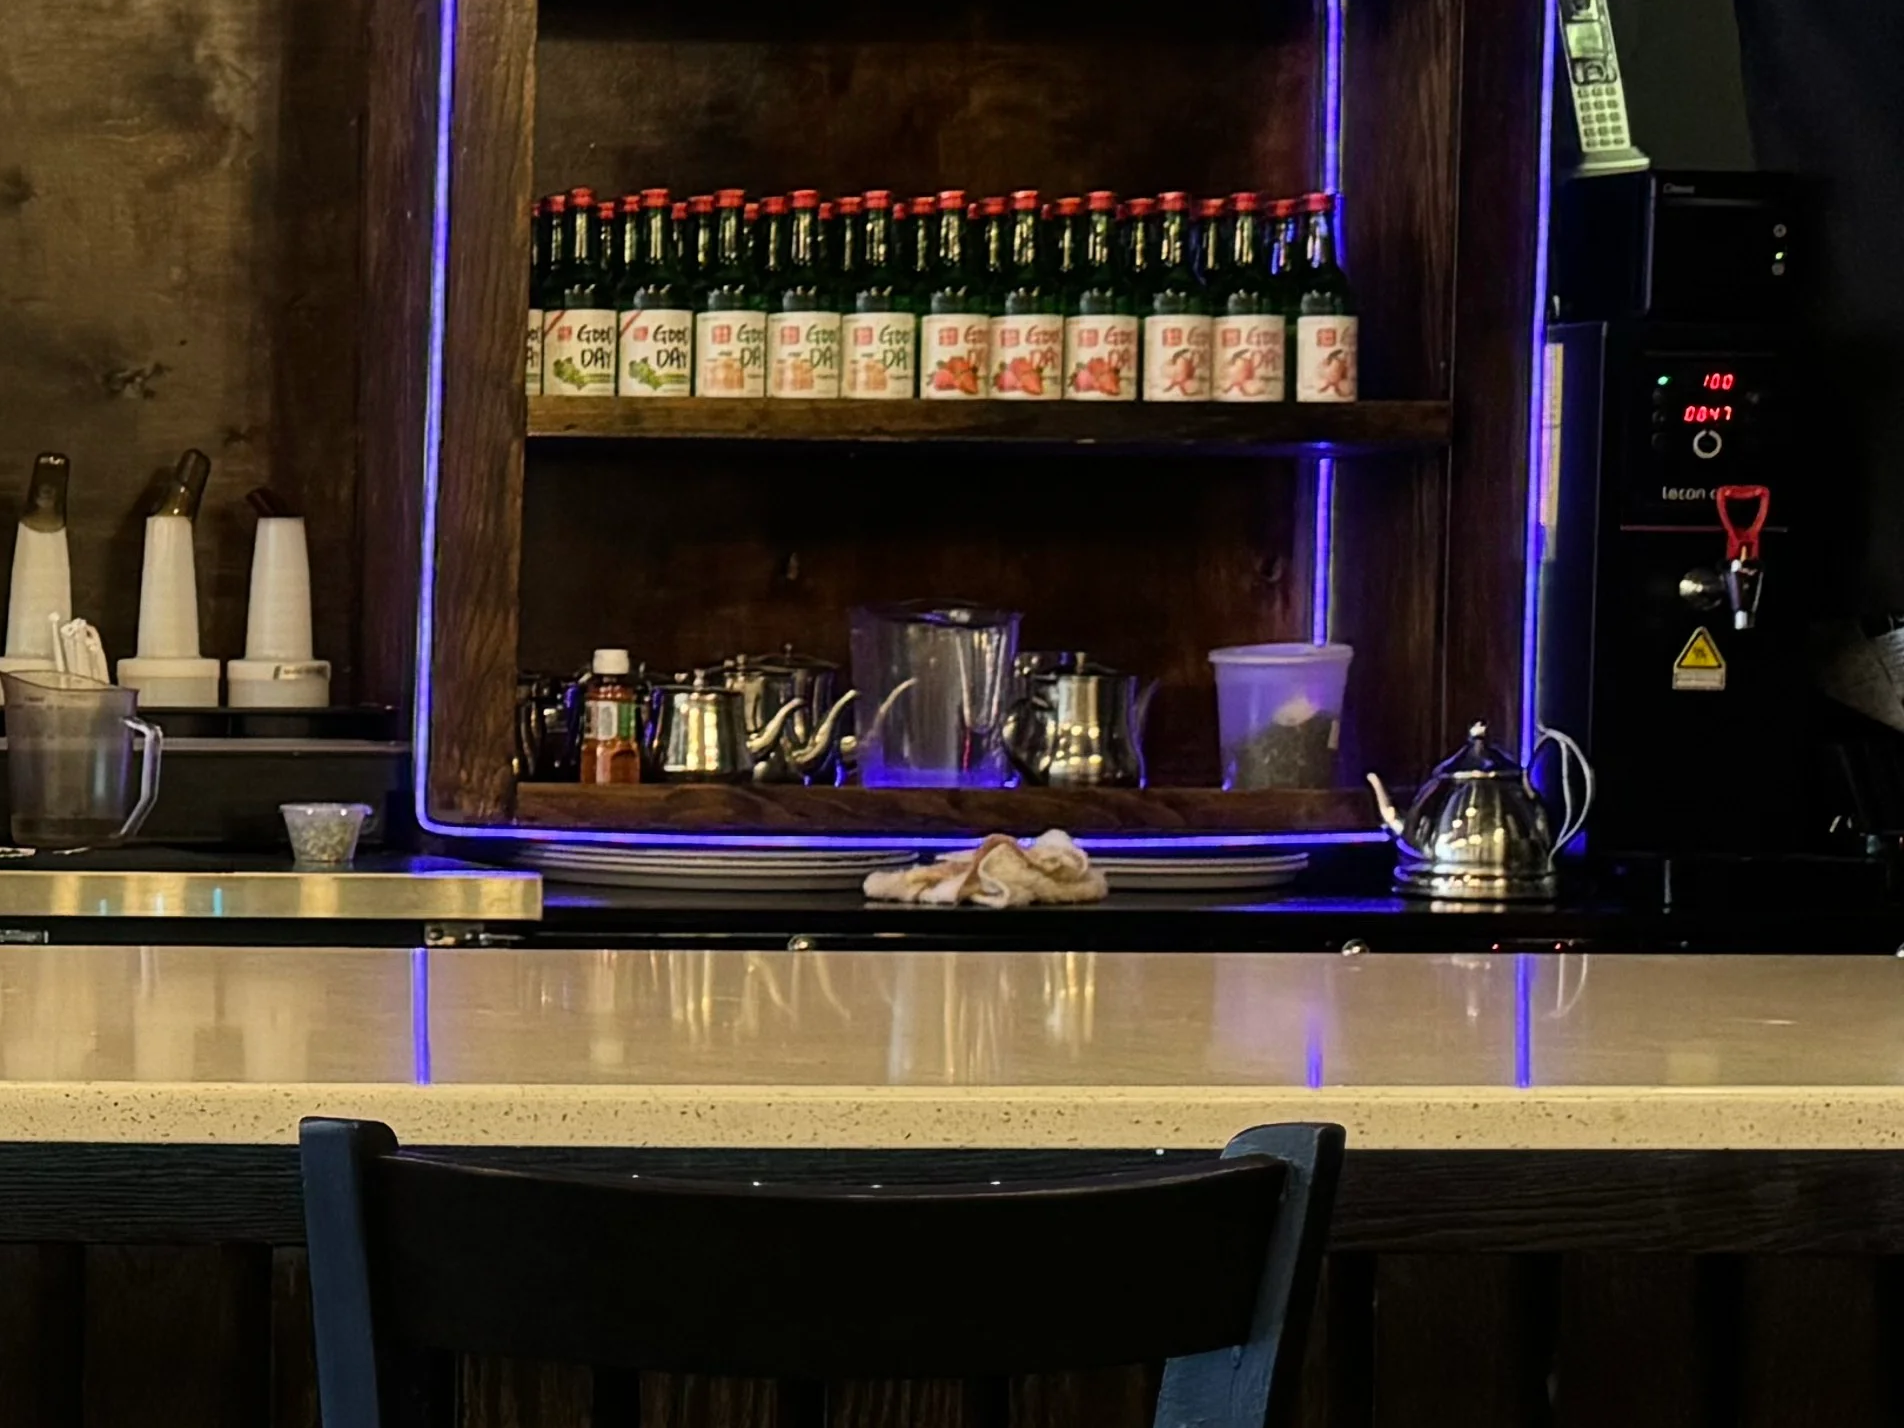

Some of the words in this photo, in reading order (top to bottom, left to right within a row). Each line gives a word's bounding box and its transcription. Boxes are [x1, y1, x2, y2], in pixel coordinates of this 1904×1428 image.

[805, 323, 838, 345] GOO
[878, 323, 910, 346] GOO
[739, 346, 763, 369] DA
[810, 346, 835, 370] DA
[882, 346, 909, 371] DA
[1703, 372, 1734, 390] 100
